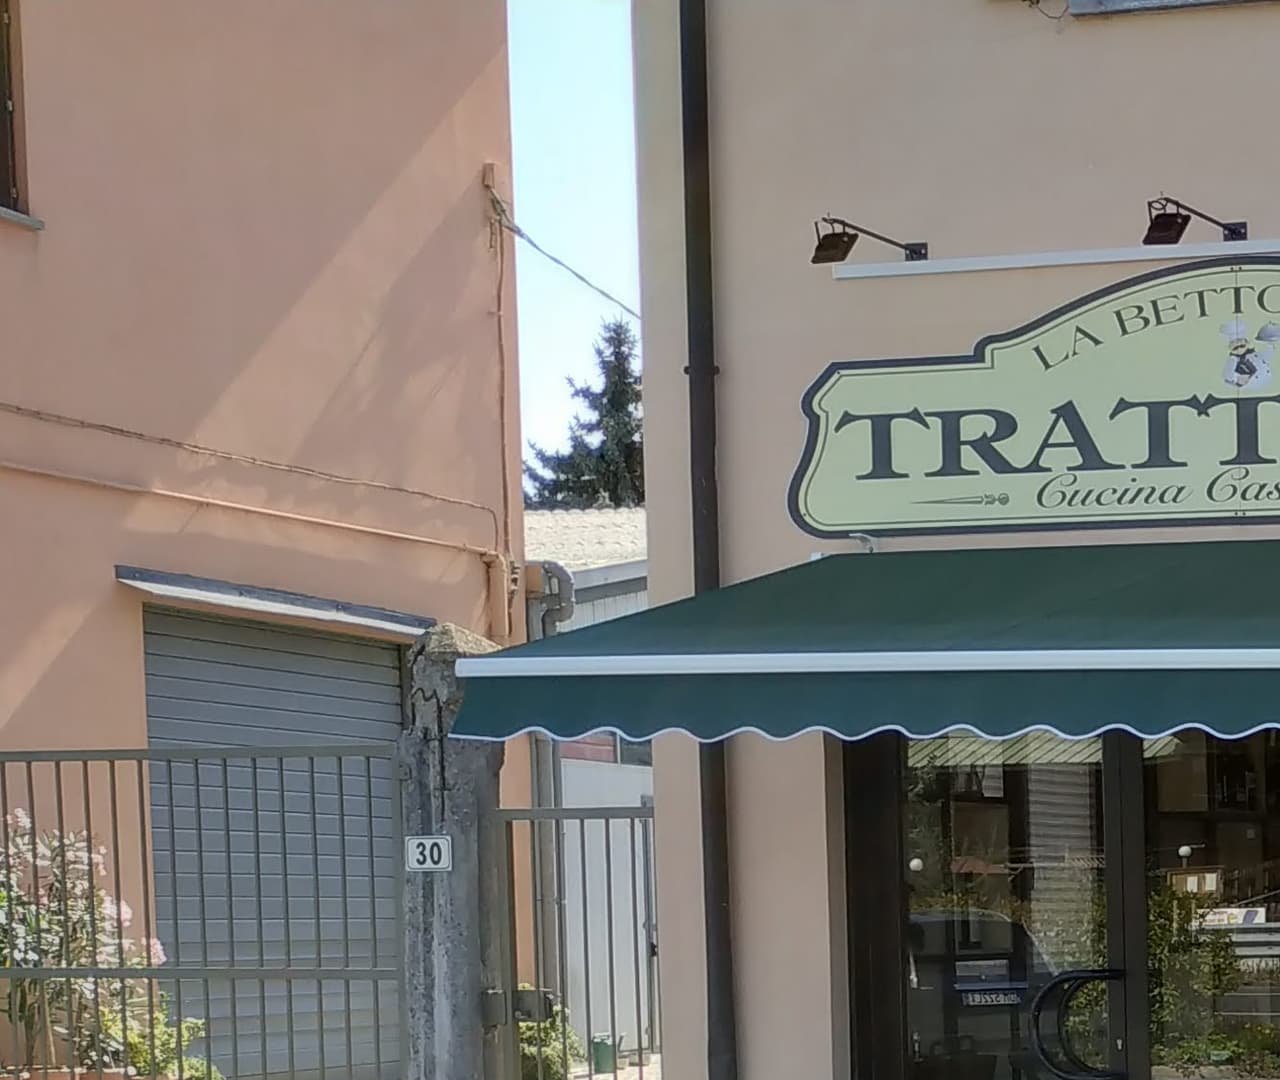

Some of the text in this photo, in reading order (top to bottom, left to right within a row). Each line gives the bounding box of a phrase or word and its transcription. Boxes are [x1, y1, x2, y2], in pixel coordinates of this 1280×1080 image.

[1033, 324, 1108, 373] LA
[1036, 470, 1191, 510] Cucina
[416, 842, 442, 865] 30
